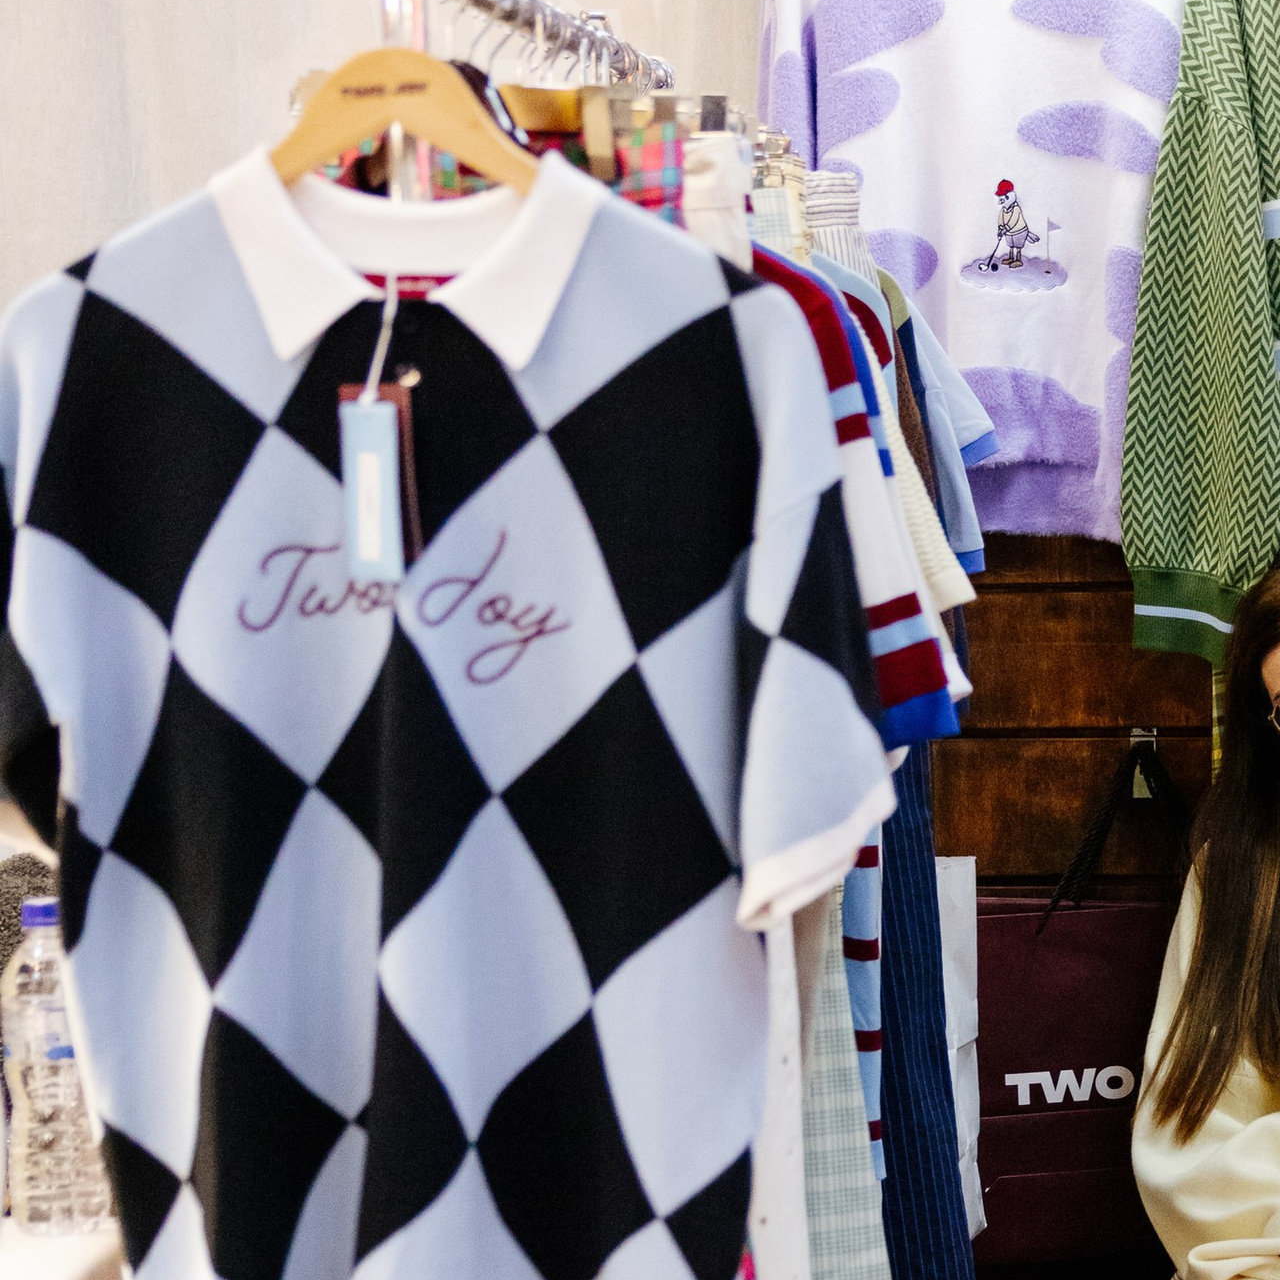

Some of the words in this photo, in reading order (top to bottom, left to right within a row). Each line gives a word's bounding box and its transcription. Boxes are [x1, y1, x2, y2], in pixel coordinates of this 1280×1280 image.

[236, 540, 399, 633] Two
[417, 527, 571, 686] Joy
[1005, 1065, 1135, 1106] TWO
